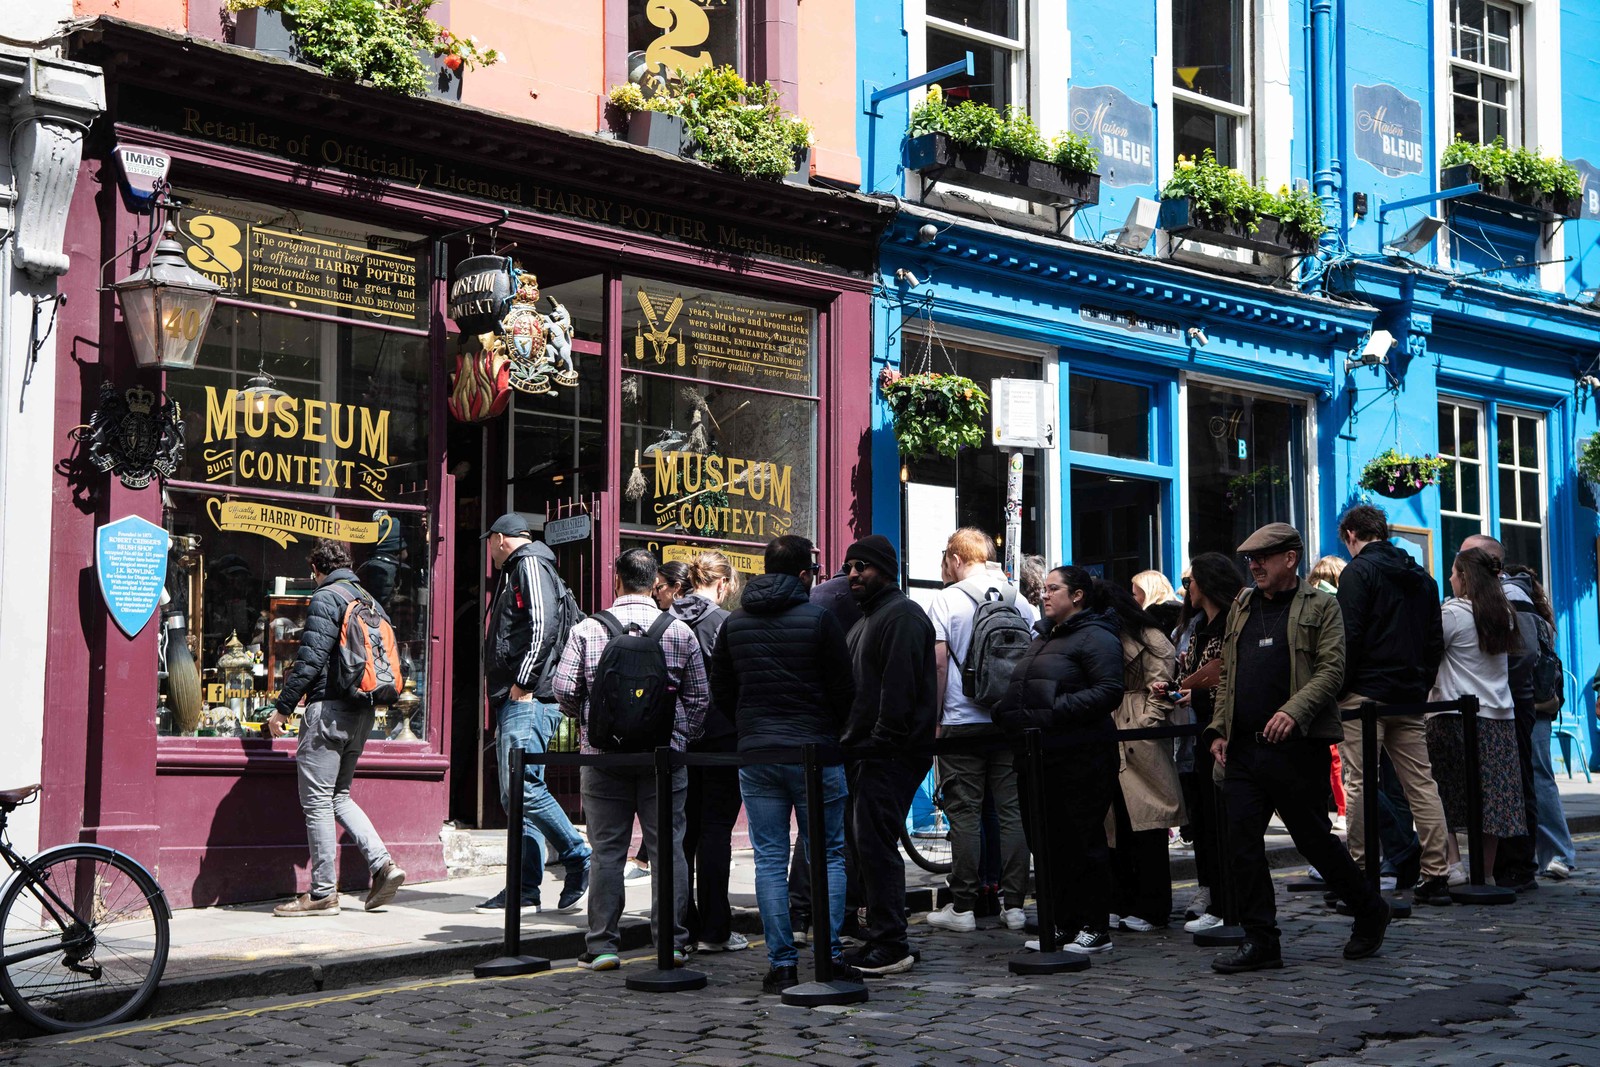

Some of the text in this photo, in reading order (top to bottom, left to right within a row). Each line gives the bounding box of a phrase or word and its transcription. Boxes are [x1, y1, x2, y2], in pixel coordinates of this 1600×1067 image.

[645, 0, 714, 74] 2
[1071, 102, 1129, 140] Maison
[1356, 105, 1404, 139] Maison
[125, 151, 165, 168] IMMS
[1103, 134, 1151, 167] BLEUE
[1382, 134, 1422, 163] BLEUE
[182, 107, 827, 265] Retailer of Officially Licensed HARRY POTTER Merchandise
[186, 215, 243, 274] 3
[253, 232, 416, 274] The original and best purveyors
[252, 248, 416, 287] of official HARRY POTTER
[252, 262, 416, 300] merchandise to the great and
[252, 276, 416, 313] good of EDINBURGH AND BEYOND!
[450, 273, 497, 303] USEUM
[165, 306, 200, 341] 40
[450, 298, 494, 320] ONTEXT
[688, 307, 809, 335] years, brushes and broomsticks
[1081, 307, 1126, 325] RESTAURANT
[688, 318, 809, 347] were sold to WIZARDS, WARLOCKS,
[691, 330, 807, 357] SORCERERS, ENCHANTERS and the
[691, 354, 727, 370] Superior
[727, 359, 755, 376] quality
[763, 367, 783, 378] never
[785, 369, 811, 383] beaten!
[694, 342, 804, 367] GENERAL PUBLIC OF EDINBURGH!
[203, 385, 391, 466] MUSEUM
[1237, 438, 1248, 460] B
[206, 449, 383, 493] BUILT CONTEXT 1840
[653, 448, 792, 514] MUSEUM
[260, 507, 298, 528] HARRY
[300, 514, 341, 536] POTTER
[656, 509, 677, 526] BUILT
[680, 503, 767, 536] CONTEXT
[728, 554, 752, 569] OTTER
